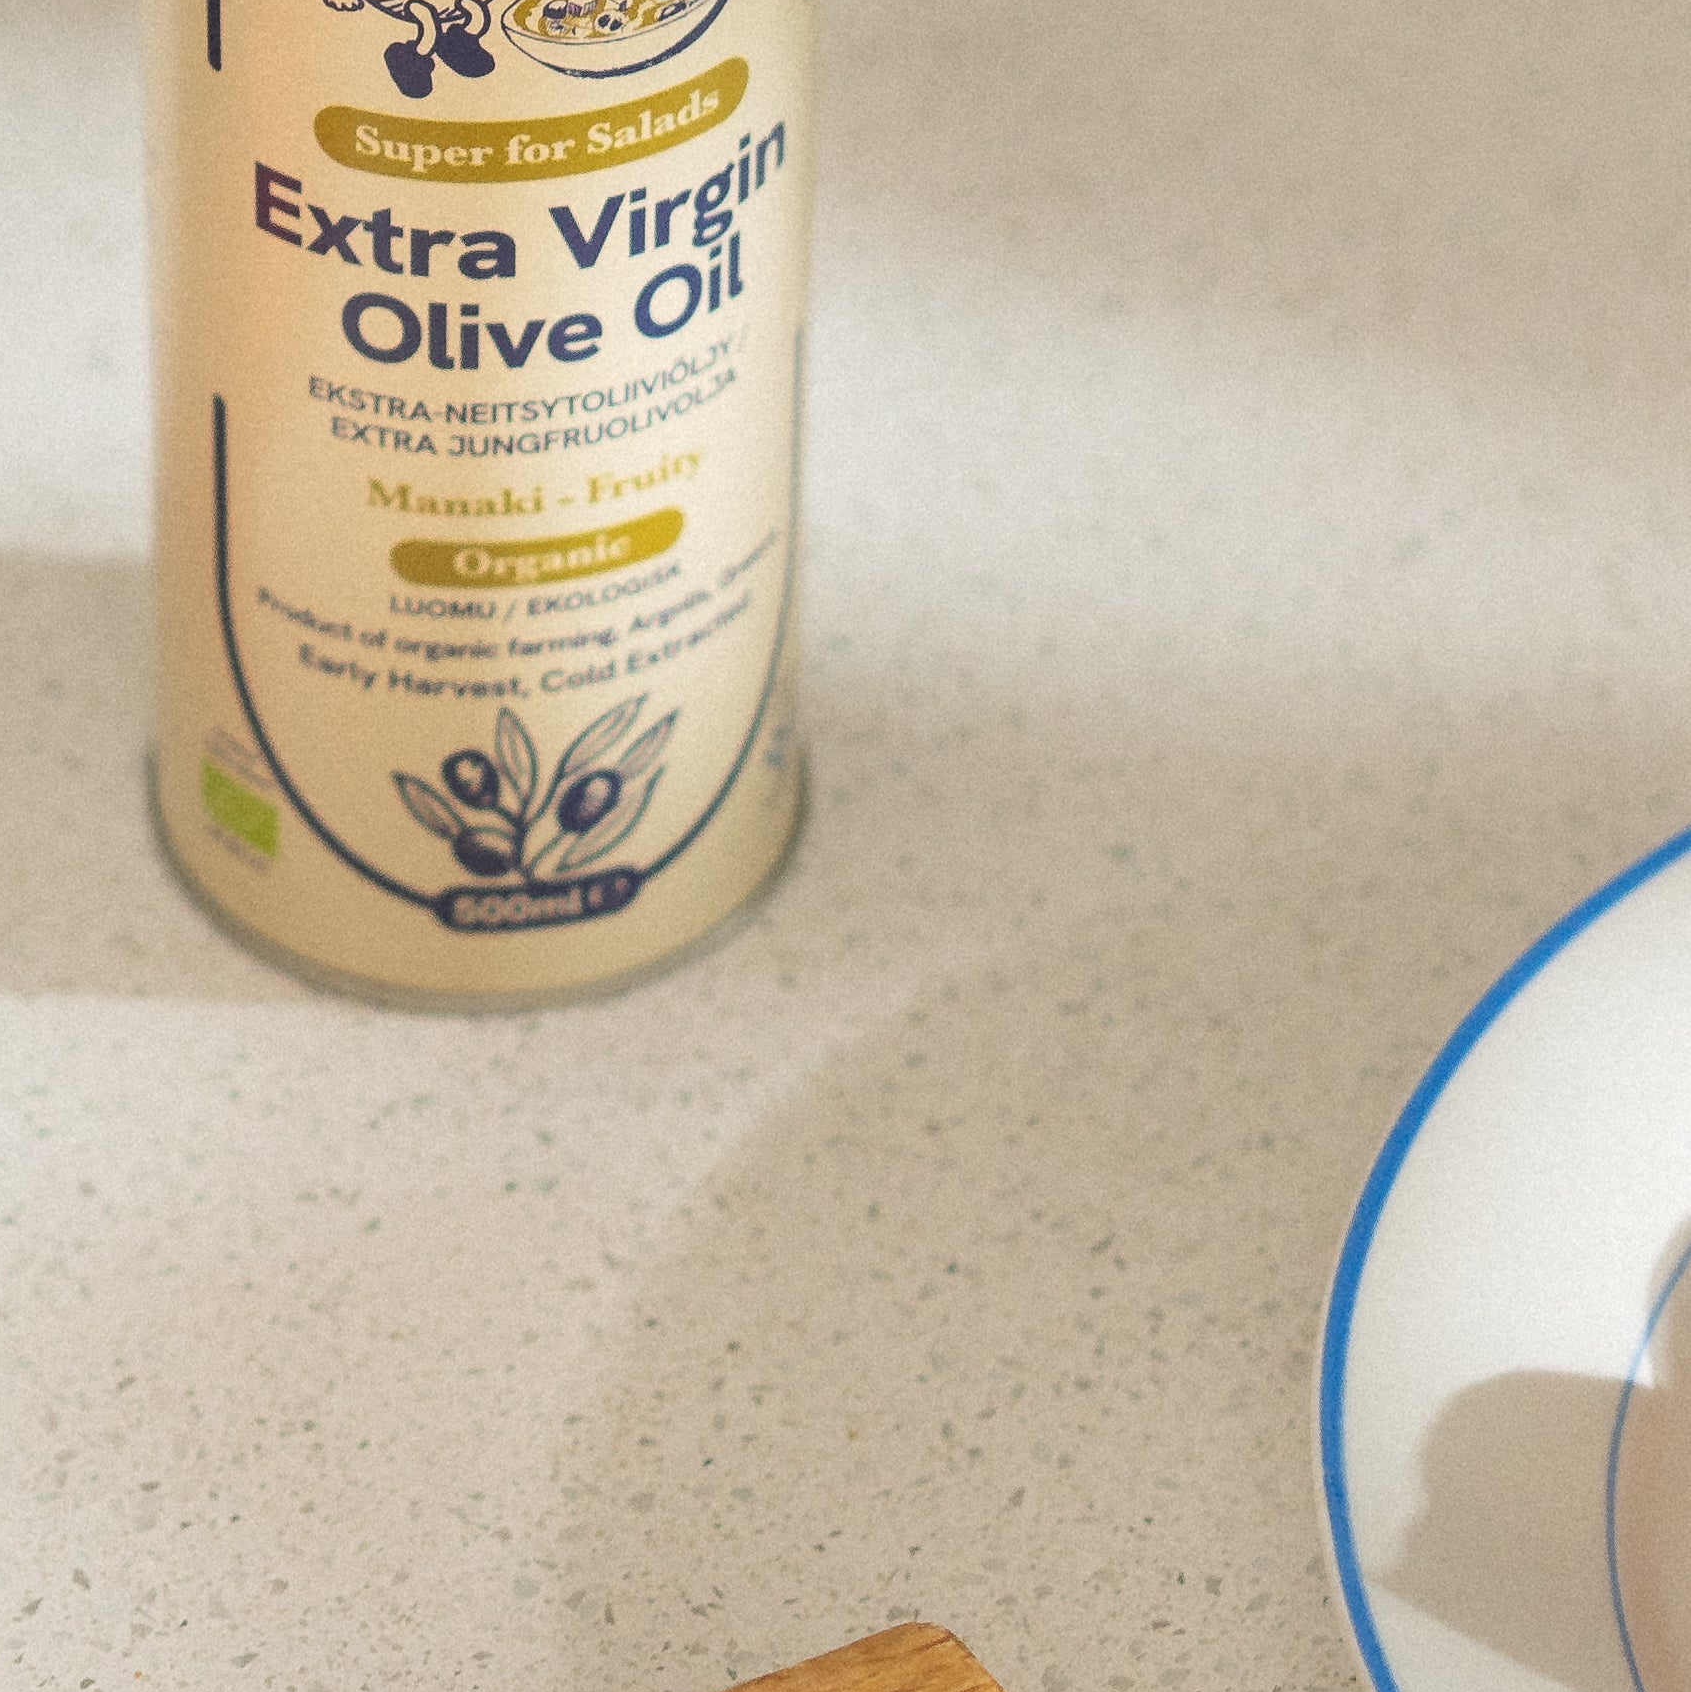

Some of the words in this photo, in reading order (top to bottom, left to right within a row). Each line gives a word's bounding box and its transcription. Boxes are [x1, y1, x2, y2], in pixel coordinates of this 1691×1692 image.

[353, 123, 494, 173] Super
[505, 133, 577, 166] for
[586, 87, 721, 155] Salads
[253, 160, 517, 281] Extra
[548, 120, 786, 271] Virgin
[340, 291, 604, 371] Olive
[633, 231, 746, 340] Oil
[329, 414, 439, 457] EXTRA
[366, 476, 544, 518] Manaki
[587, 446, 703, 506] Fruity
[451, 532, 633, 584] Organic
[389, 594, 498, 620] LUOMU
[297, 640, 378, 691] Early
[387, 668, 533, 700] Harvest,
[539, 659, 618, 693] Cold
[359, 629, 388, 650] of
[394, 637, 500, 663] organic
